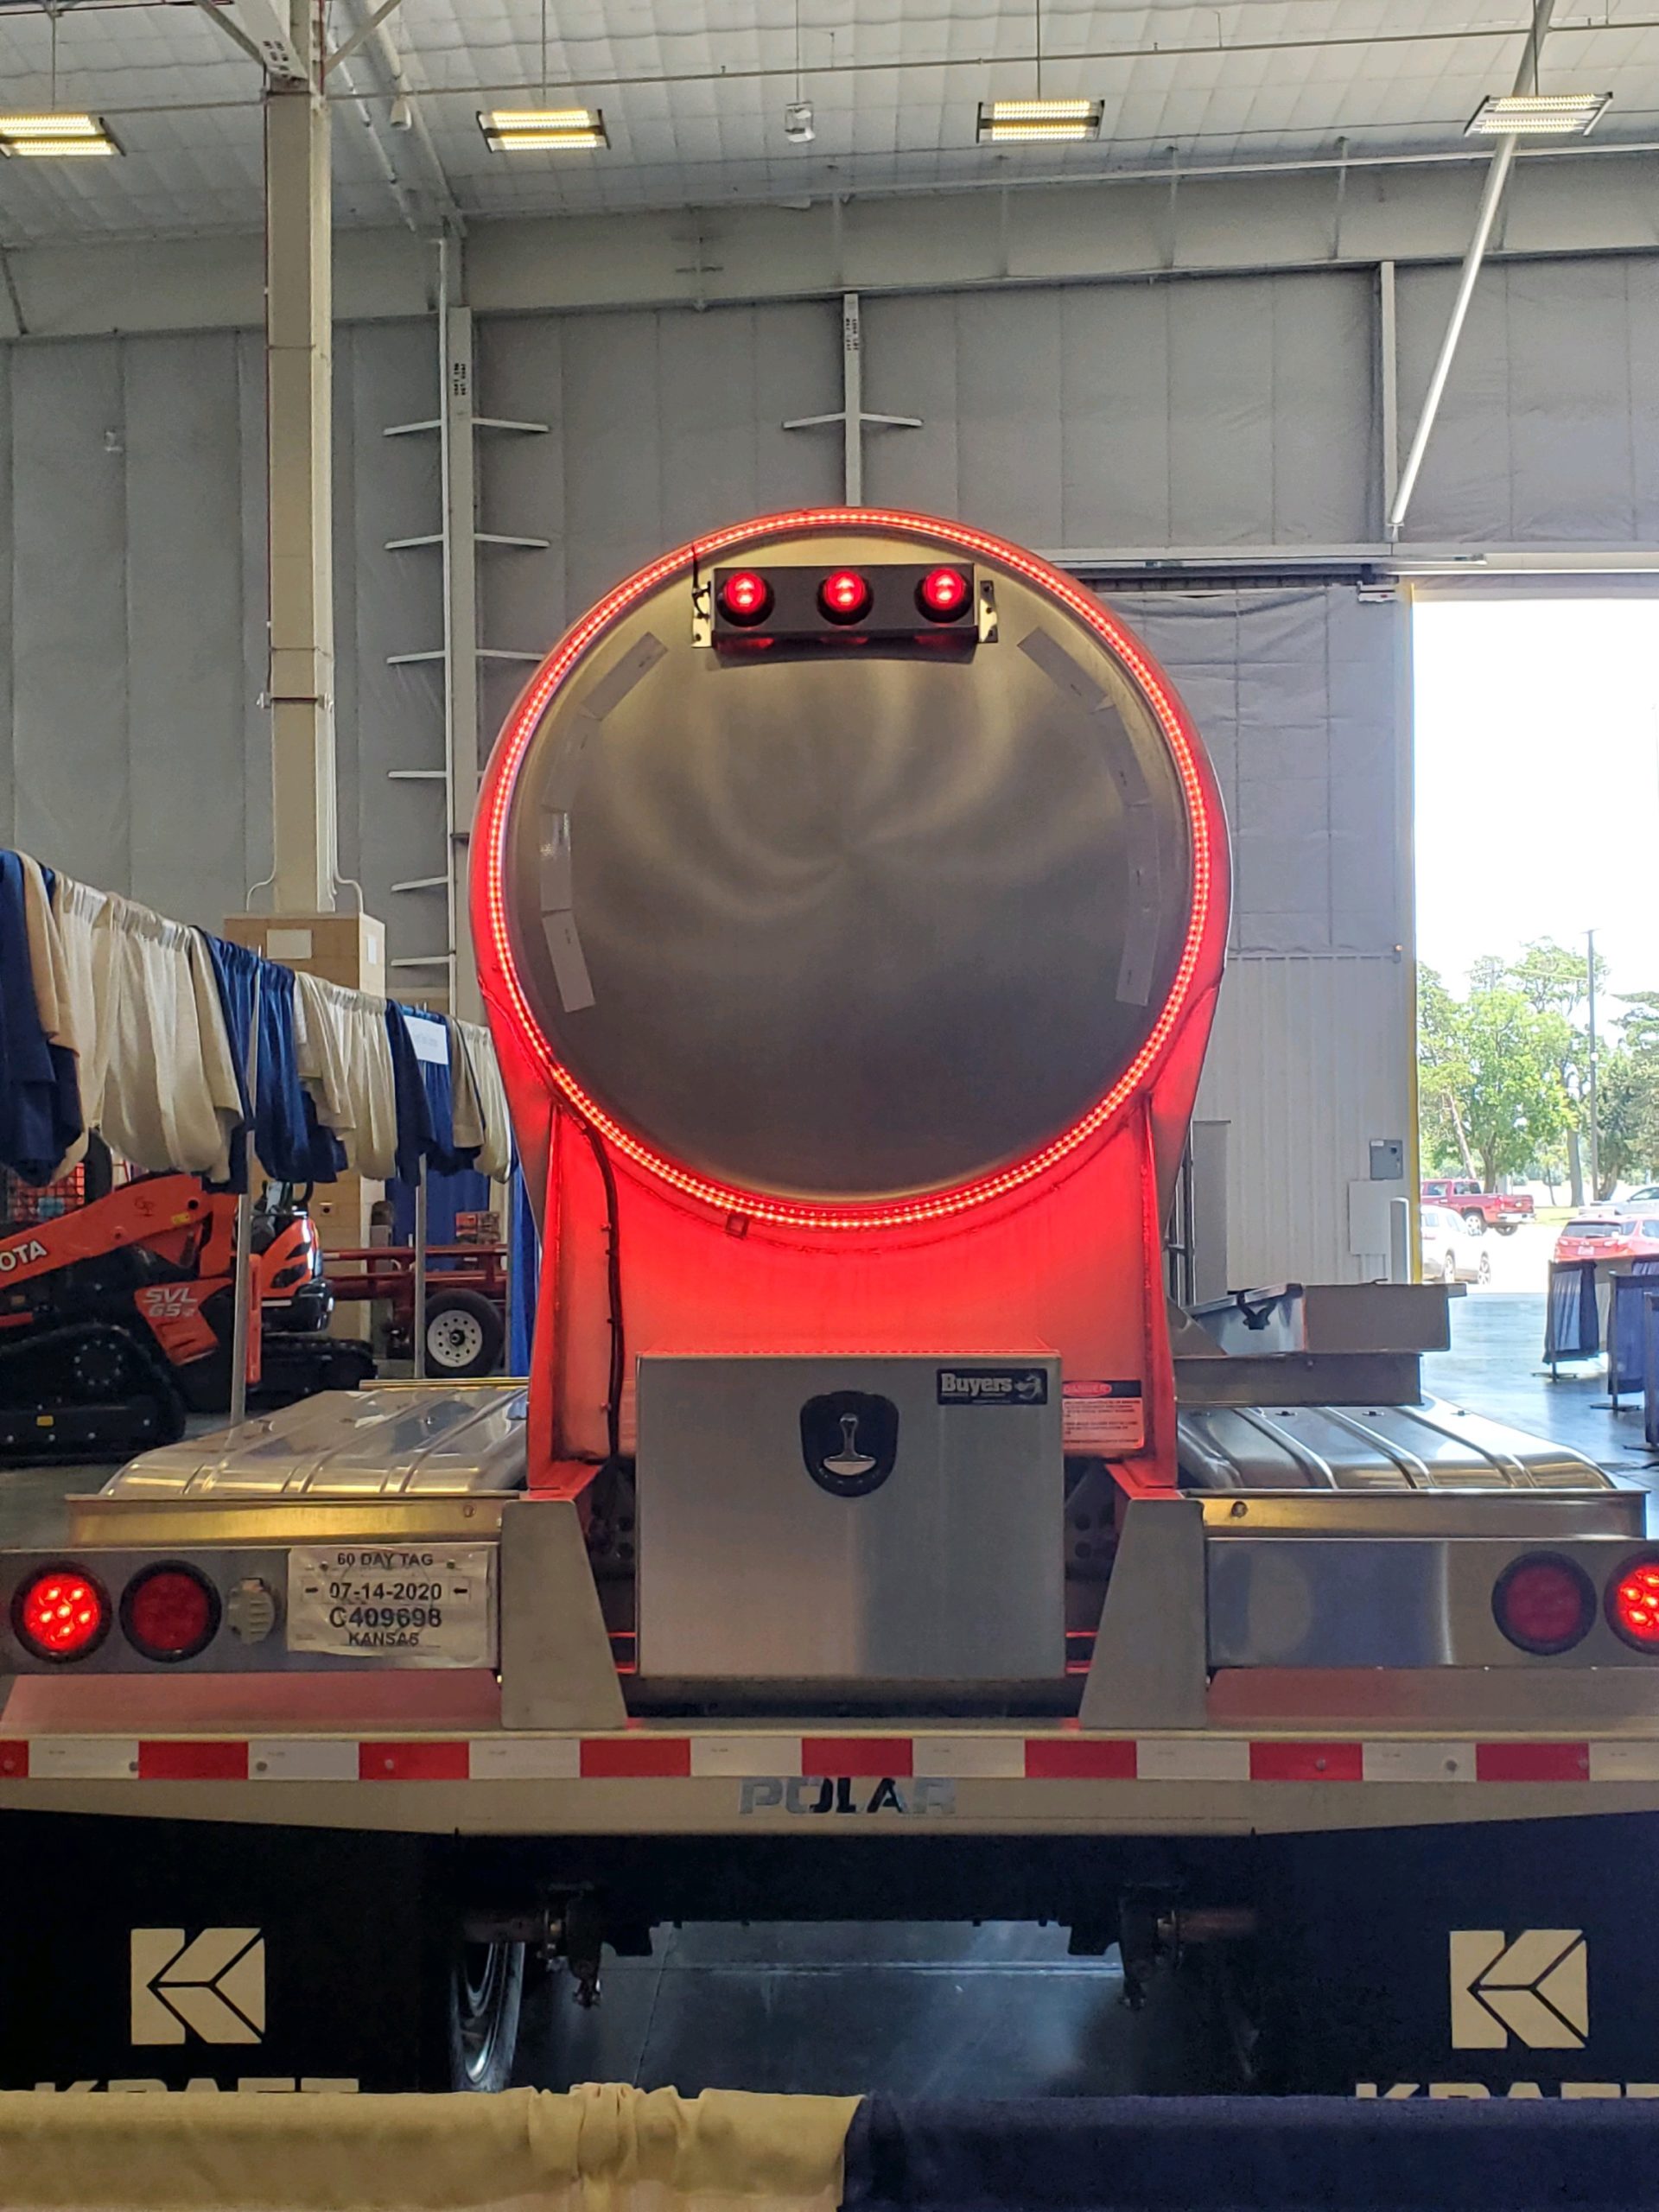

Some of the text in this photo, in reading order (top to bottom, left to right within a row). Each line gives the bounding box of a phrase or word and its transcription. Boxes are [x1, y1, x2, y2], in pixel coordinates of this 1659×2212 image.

[143, 1287, 197, 1303] SVL
[941, 1373, 1012, 1396] Buyers
[338, 1554, 434, 1567] 60 DAY TAG
[329, 1582, 442, 1599] 07-14-2020
[329, 1606, 442, 1628] C409698
[349, 1631, 419, 1646] KANSAS
[739, 1777, 956, 1814] POLAR
